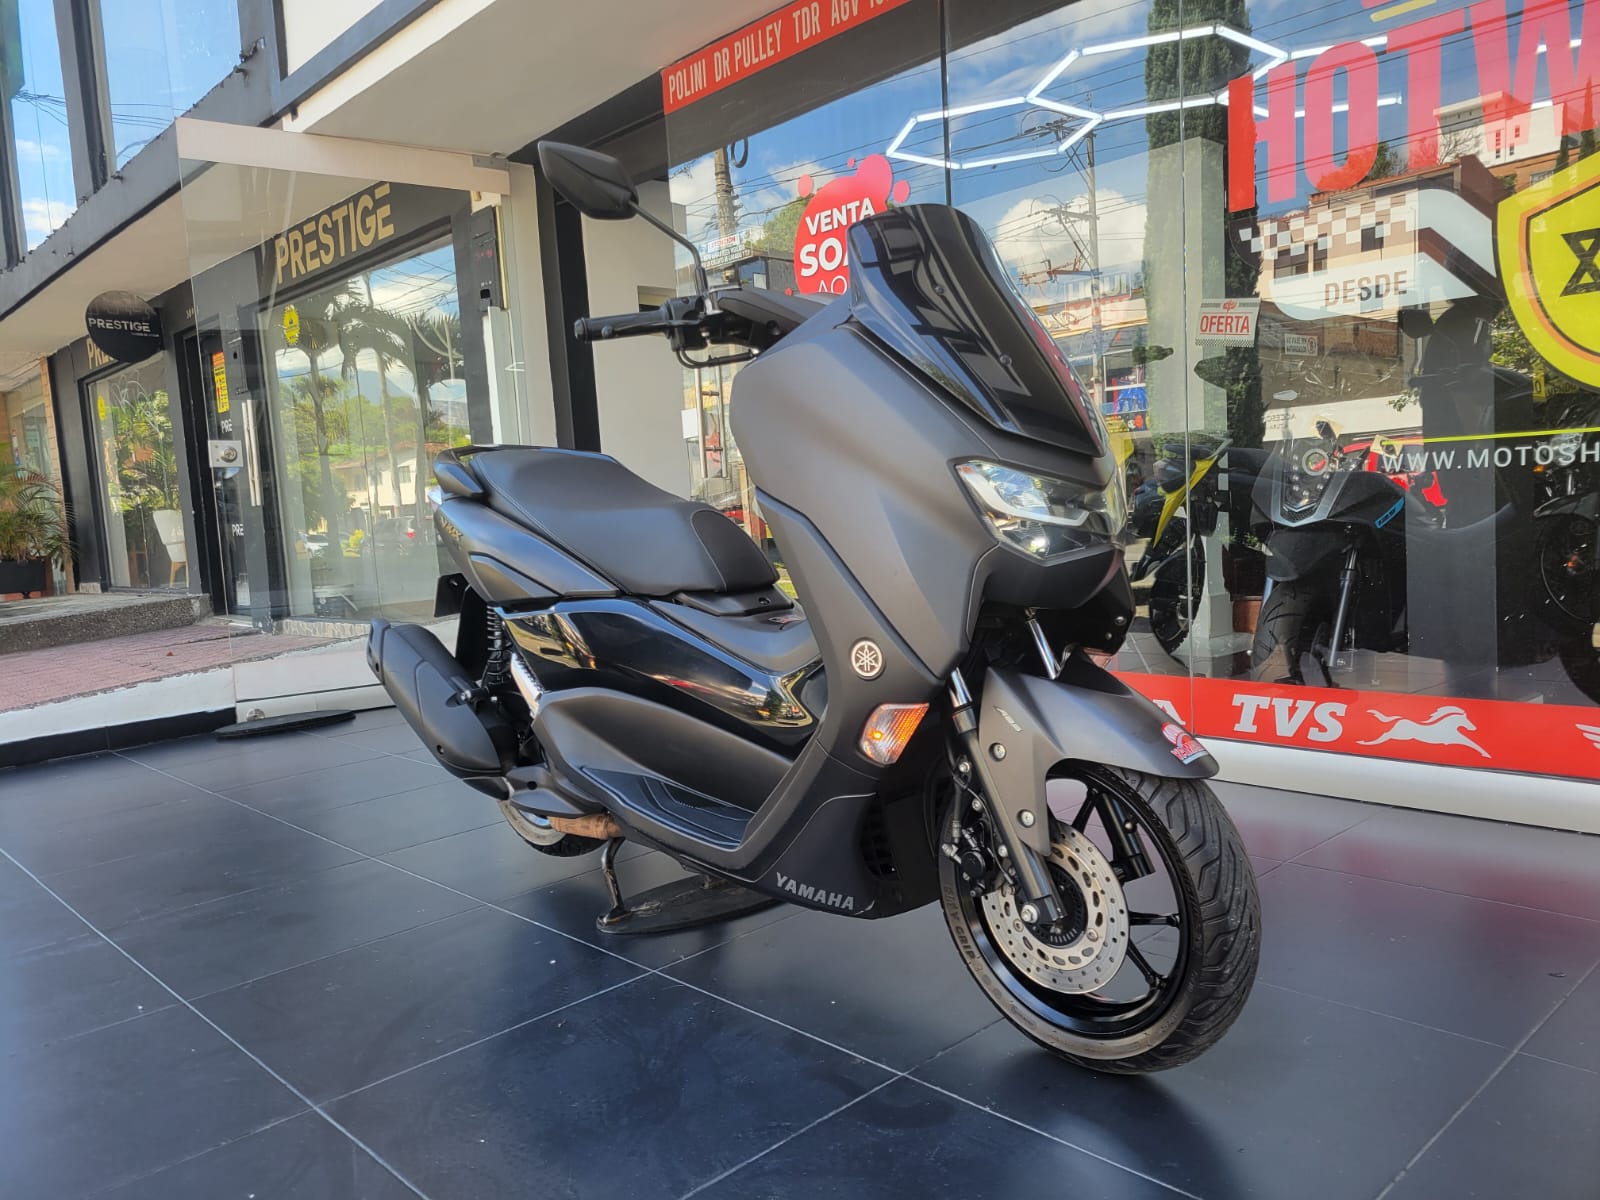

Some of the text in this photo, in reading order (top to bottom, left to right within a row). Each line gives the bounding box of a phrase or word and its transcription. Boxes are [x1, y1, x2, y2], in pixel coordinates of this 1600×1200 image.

[668, 58, 707, 104] POLINI
[714, 47, 731, 82] DR
[734, 20, 782, 72] PULLEY
[793, 1, 821, 43] TDR
[275, 183, 394, 284] PRESTIGE
[805, 197, 875, 236] VENTA
[800, 237, 848, 277] SO
[1324, 270, 1408, 307] DESDE
[88, 317, 151, 332] PRESTIGE
[1200, 315, 1250, 333] OFERTA
[1383, 441, 1600, 473] WWW.MOTOSH
[1232, 694, 1347, 742] TVS
[776, 872, 854, 910] YAMAHA
